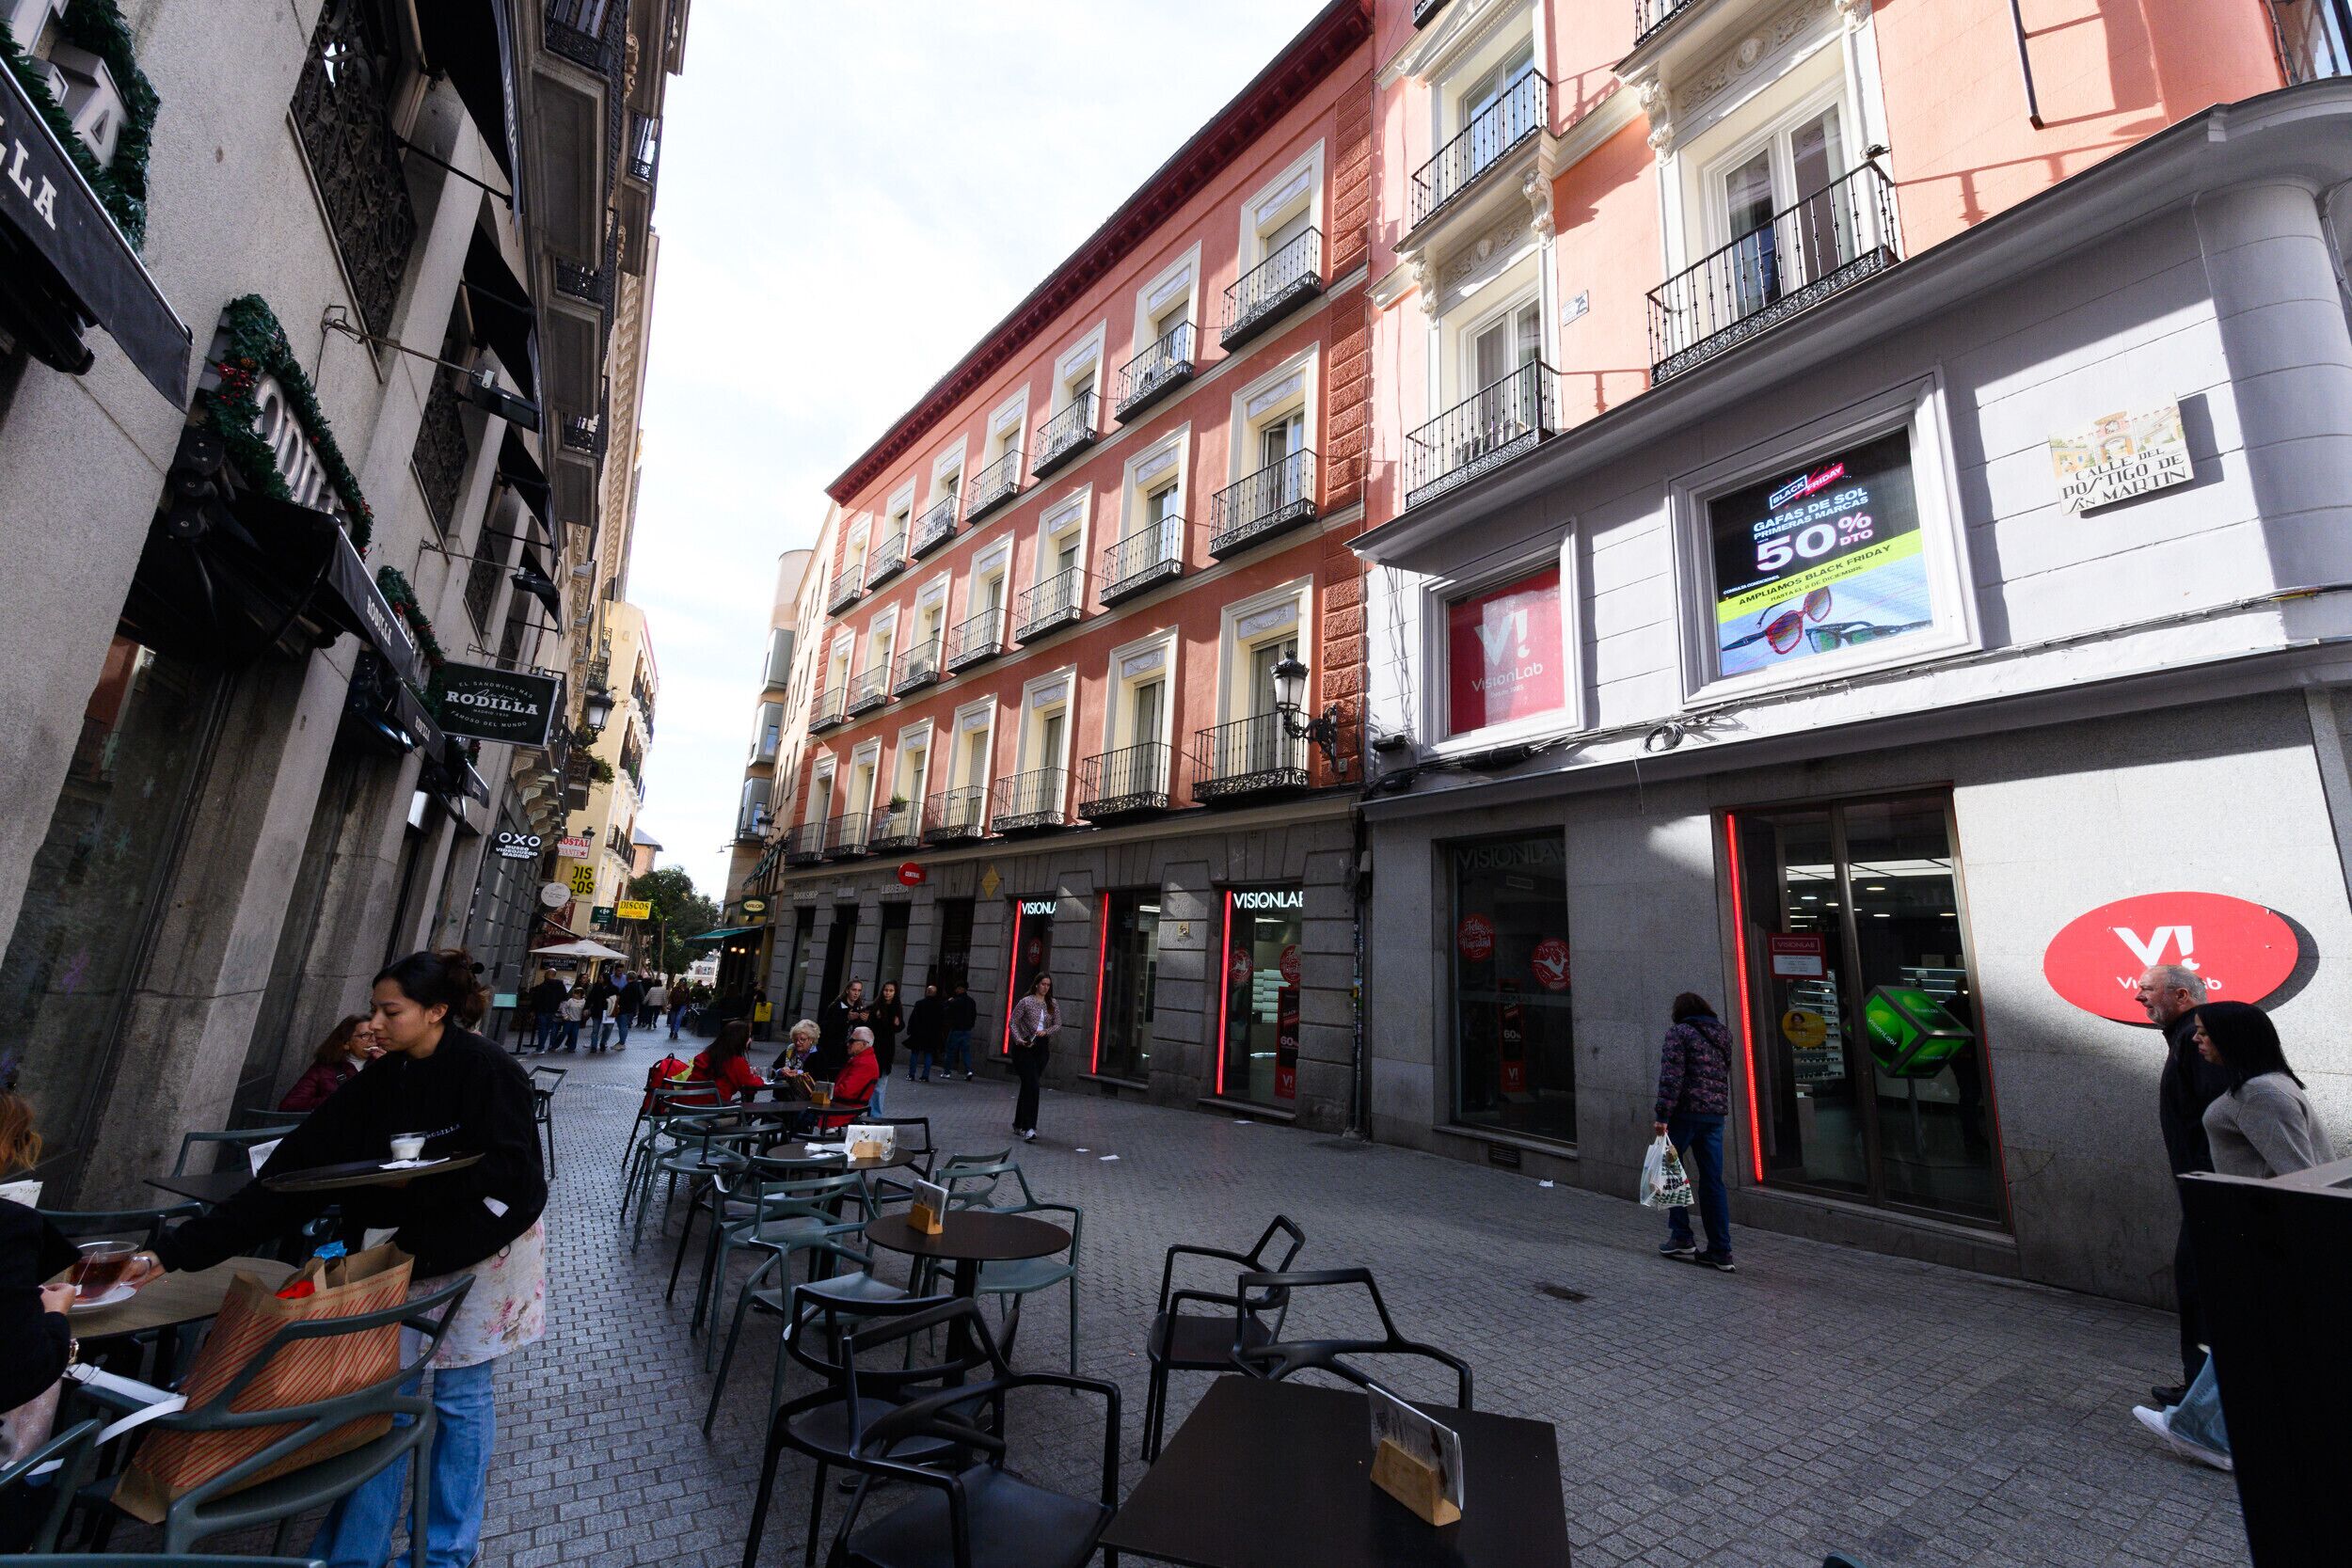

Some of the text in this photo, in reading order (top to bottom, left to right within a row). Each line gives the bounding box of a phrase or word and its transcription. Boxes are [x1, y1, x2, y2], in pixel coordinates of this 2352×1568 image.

[2062, 453, 2185, 499] POSTIGO DE
[2075, 448, 2164, 481] CALLE DEL
[1772, 466, 1842, 504] BLACK FRIDAY
[2070, 467, 2186, 514] SAN MARTIN
[1754, 487, 1867, 532] GAFAS DE SOL
[1754, 495, 1868, 540] PRIMERAS MARCAS
[1839, 529, 1874, 546] DTO
[1740, 545, 1891, 606] AMPLIAMOS BLACK FRIDAY
[1747, 575, 1780, 588] CONDICIONES
[1771, 590, 1794, 601] HASTA
[1822, 565, 1863, 583] DICIEMBRE
[473, 681, 516, 690] SANDWICH
[1471, 662, 1543, 692] VisionLab
[445, 690, 538, 715] RODILLA
[452, 710, 480, 724] FAMOSO
[496, 847, 538, 857] VIDEOJUEGO
[499, 832, 541, 847] OXO
[620, 900, 650, 911] DISCOS
